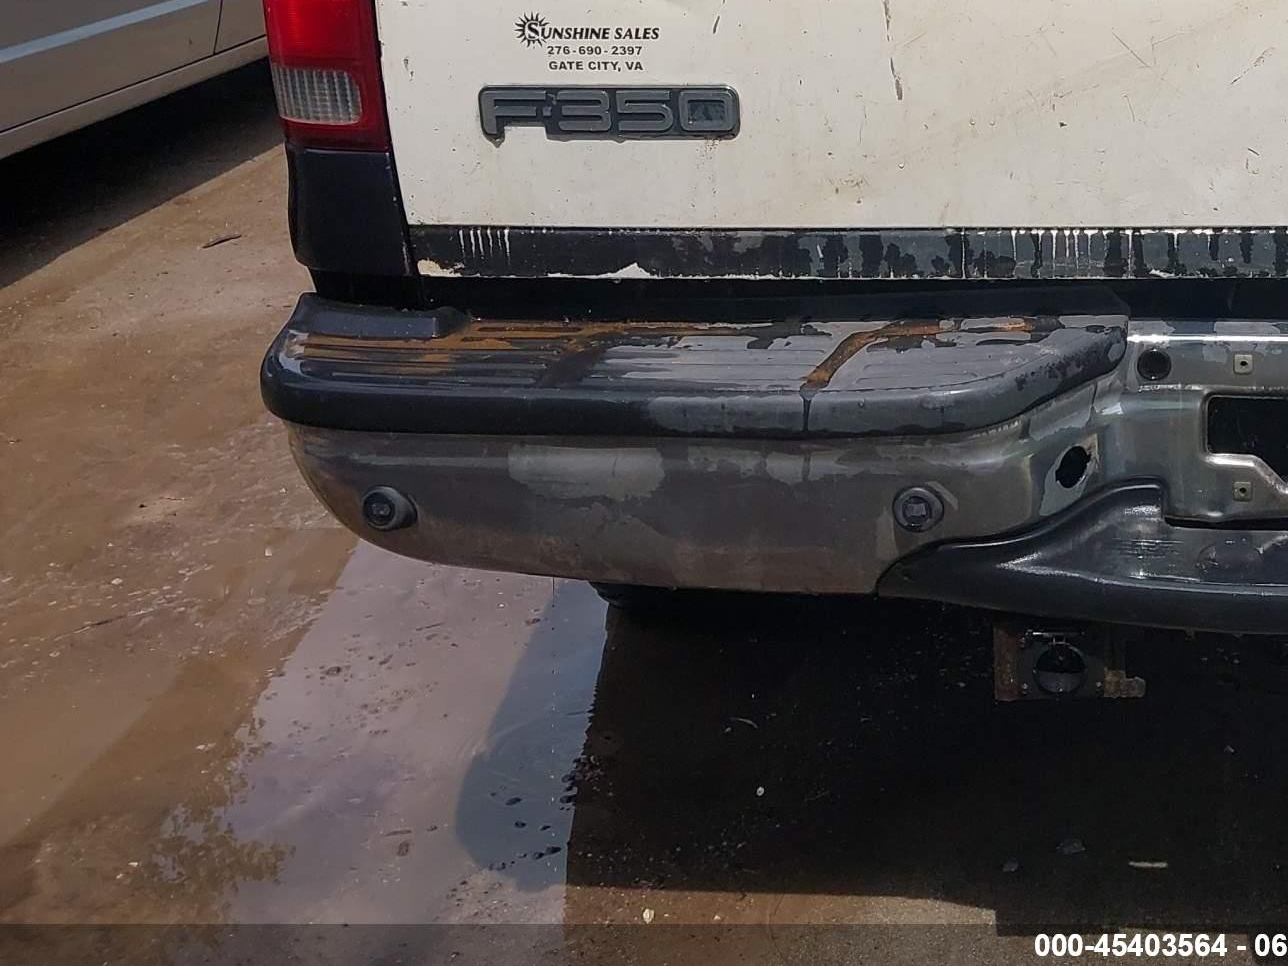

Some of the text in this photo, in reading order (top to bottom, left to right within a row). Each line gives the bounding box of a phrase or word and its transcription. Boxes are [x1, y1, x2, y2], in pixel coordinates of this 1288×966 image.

[527, 22, 660, 40] SUNSHINE SALES
[549, 61, 644, 73] GATE CITY, VA
